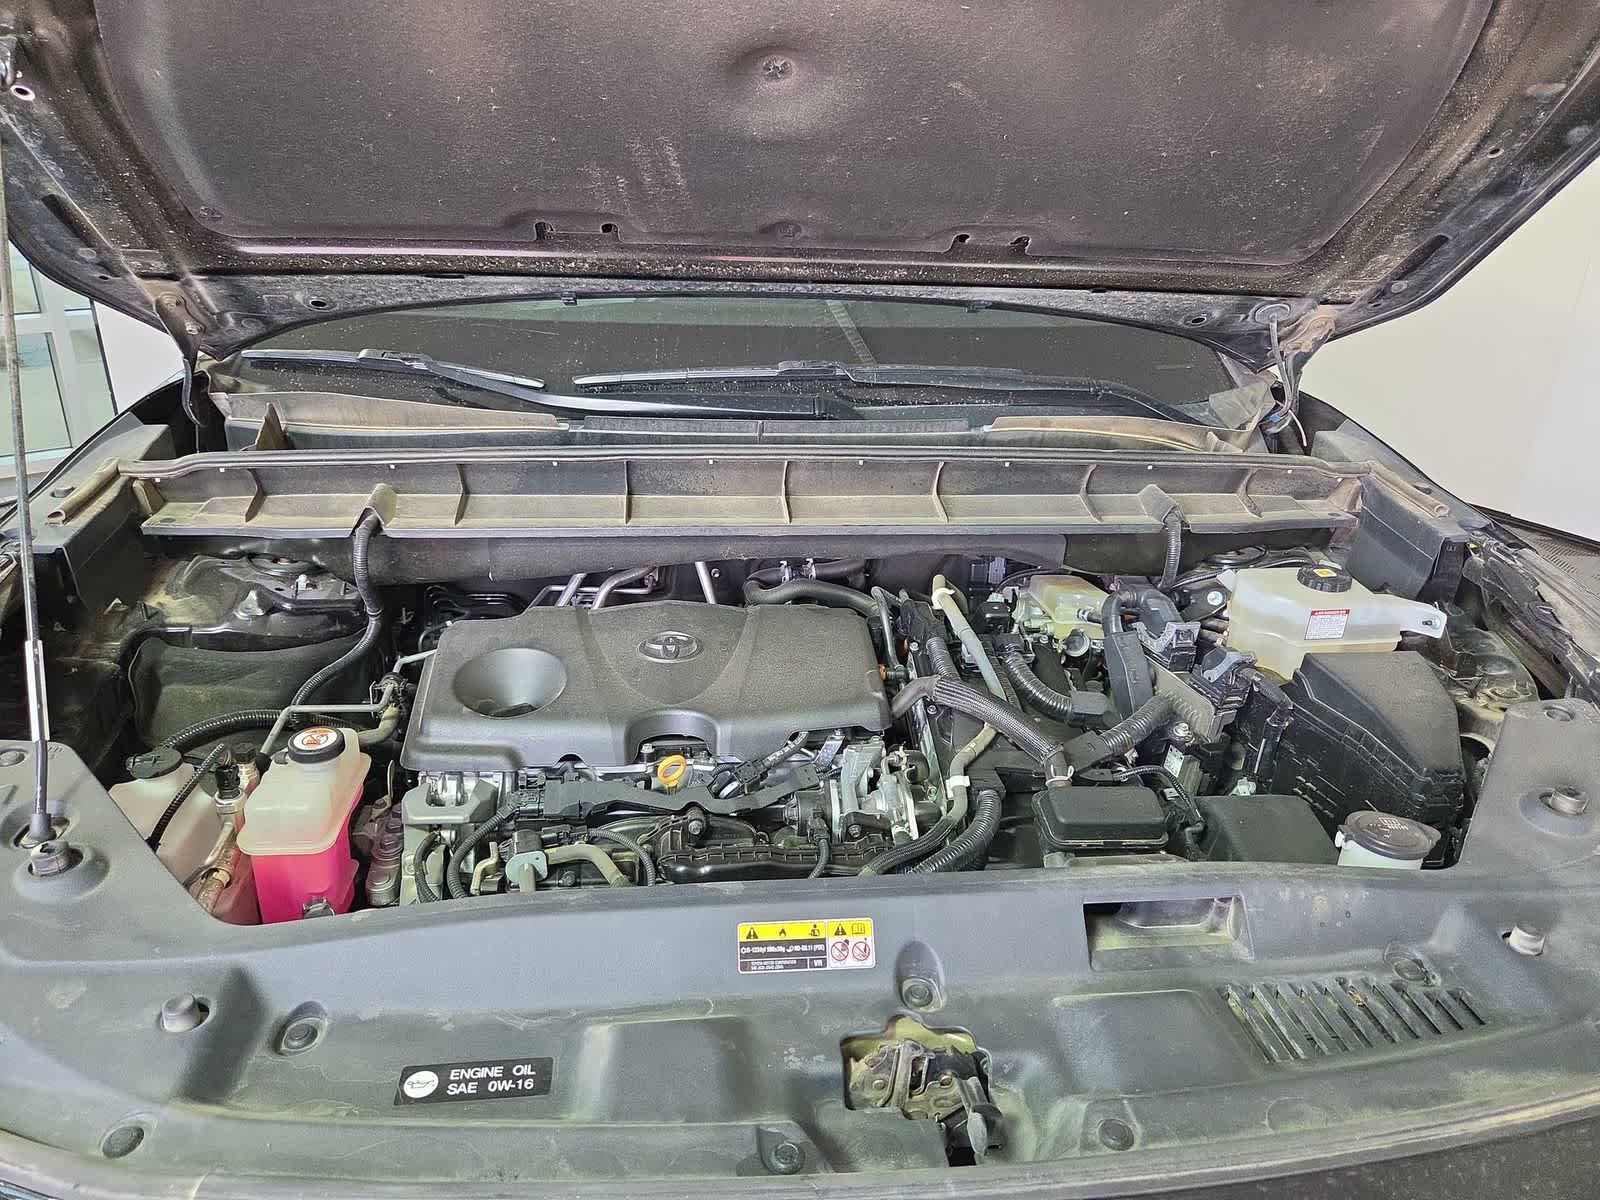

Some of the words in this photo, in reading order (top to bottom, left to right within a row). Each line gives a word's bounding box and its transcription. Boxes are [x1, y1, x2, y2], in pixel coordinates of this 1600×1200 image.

[450, 1066, 504, 1080] ENGINE
[512, 1064, 536, 1076] OIL
[447, 1081, 478, 1095] SAE
[488, 1078, 534, 1092] 0W-16
